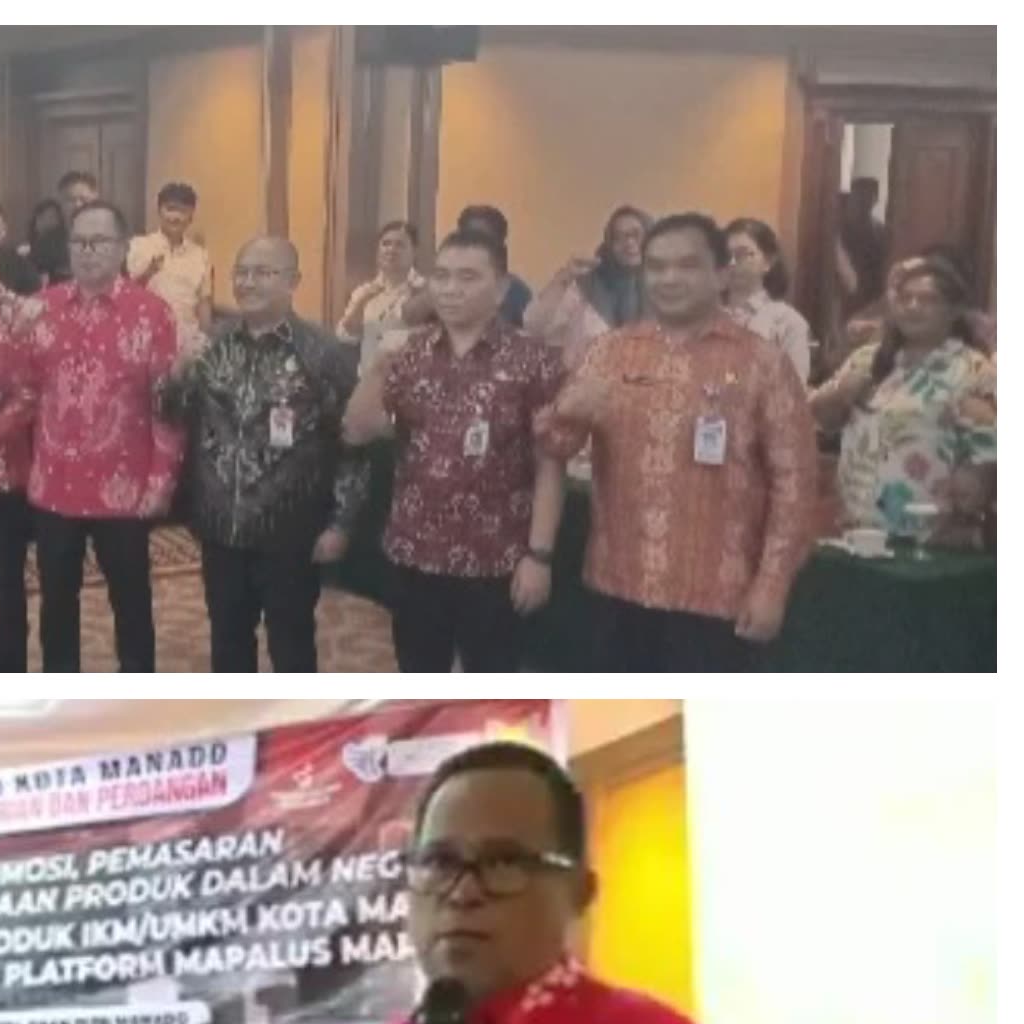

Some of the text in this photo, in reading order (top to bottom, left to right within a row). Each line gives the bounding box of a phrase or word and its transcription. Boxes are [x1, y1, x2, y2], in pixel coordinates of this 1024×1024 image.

[15, 765, 87, 792] KOTA
[101, 742, 227, 780] MANADO
[87, 828, 285, 876] PEMASARAN
[63, 872, 192, 911] PRODUK
[201, 860, 323, 896] DALAM
[331, 849, 404, 883] NEG
[80, 906, 248, 948] IKM/UMKM
[257, 900, 348, 933] KOTA
[4, 949, 168, 988] PLATFORM
[175, 936, 333, 976] MAPALUS
